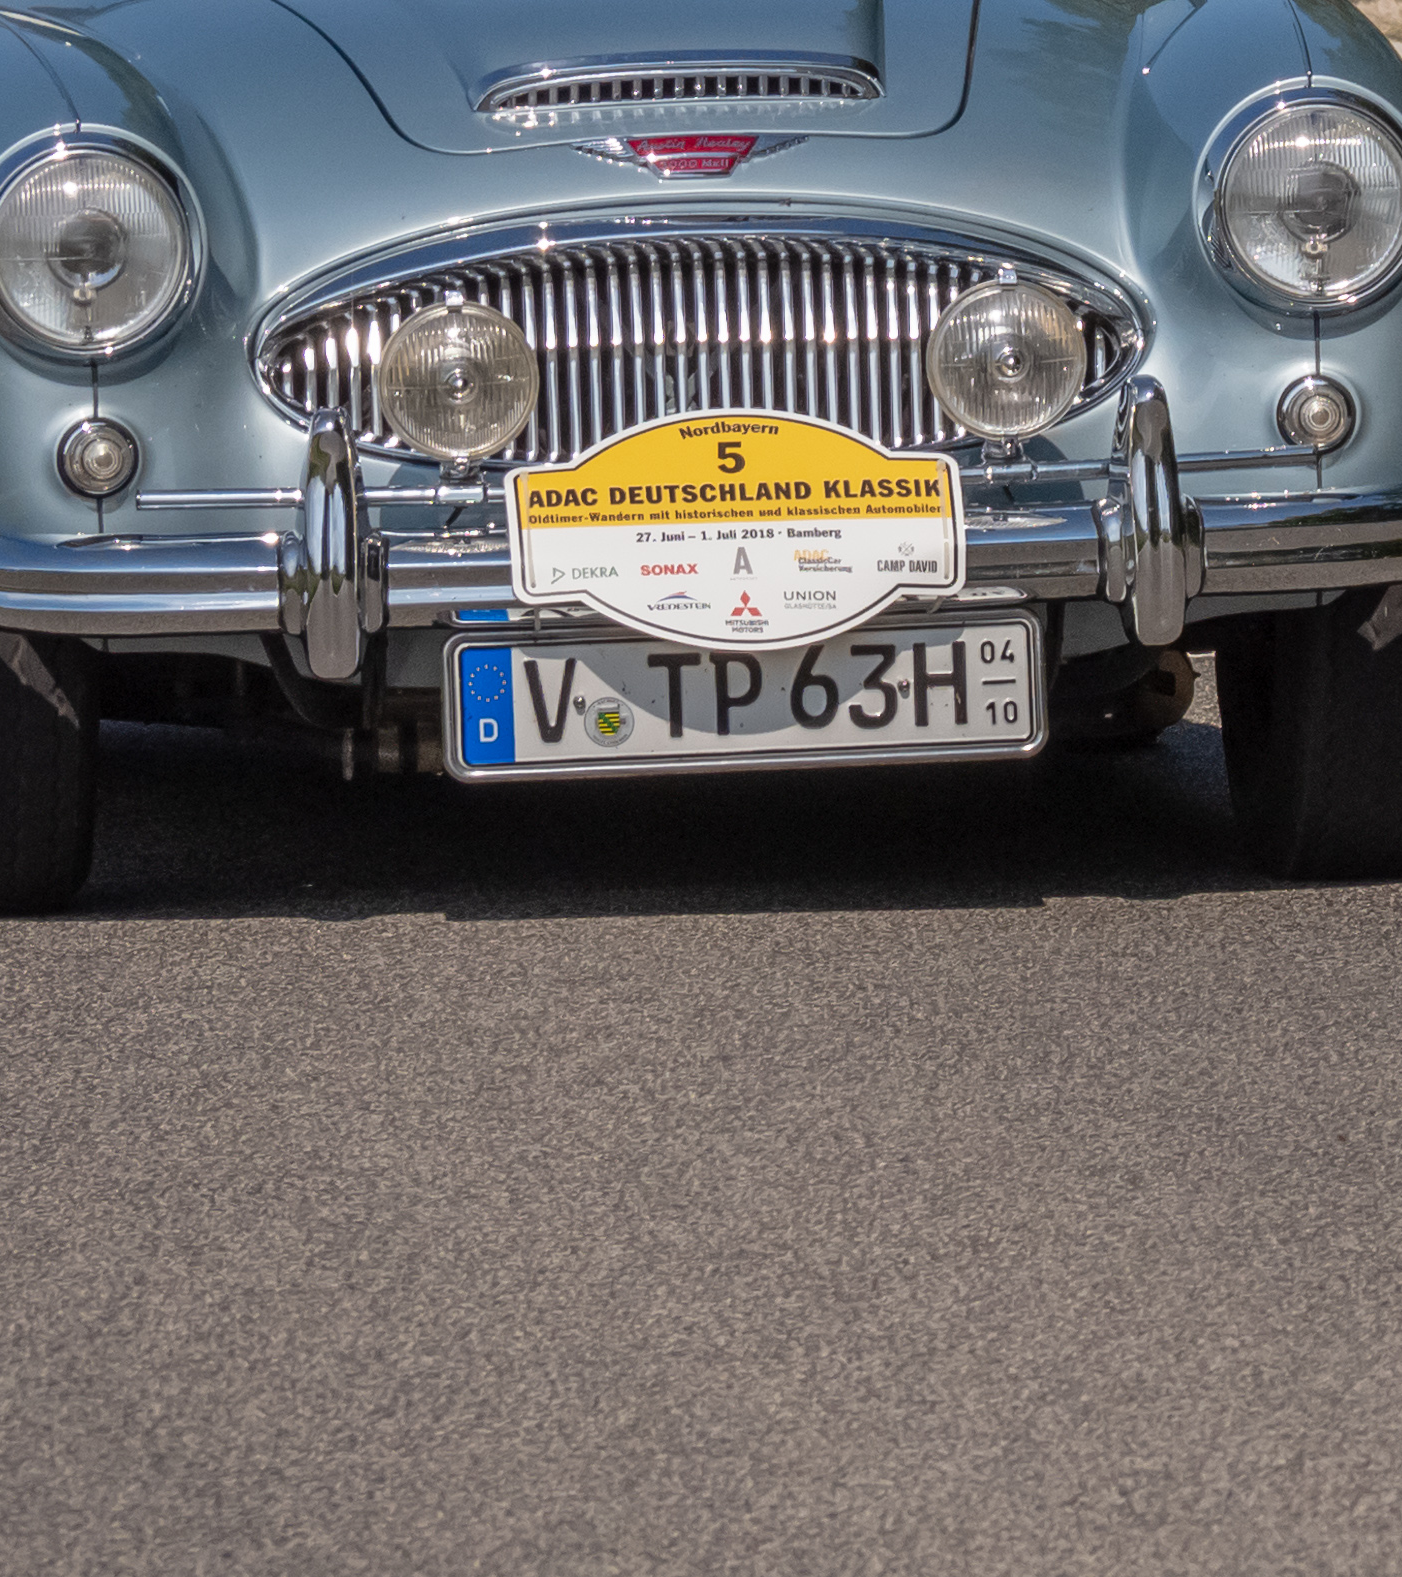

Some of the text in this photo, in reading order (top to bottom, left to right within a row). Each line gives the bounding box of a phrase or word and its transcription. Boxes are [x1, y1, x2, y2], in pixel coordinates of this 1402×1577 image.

[679, 420, 780, 440] Nordbayern
[717, 441, 746, 474] 5
[529, 479, 940, 508] ADAC DEUTSCHLAND KLASSIK
[528, 511, 645, 524] Oldtimer-Wandern
[649, 510, 670, 521] mit
[675, 508, 754, 520] historischen
[759, 507, 782, 517] und
[787, 505, 861, 516] klassischen
[636, 532, 657, 542] 27.
[661, 531, 685, 542] Juni
[701, 530, 712, 541] 1.
[716, 529, 737, 541] Juli
[741, 528, 775, 540] 2018
[787, 527, 842, 539] Bamberg
[572, 566, 619, 579] DEKRA
[640, 563, 699, 576] SONAX
[877, 560, 938, 573] CAMP DAVID
[783, 590, 837, 601] UNION
[981, 640, 1015, 664] 04
[523, 641, 969, 743] V TP 63H
[986, 701, 1017, 725] 10
[478, 718, 499, 743] D
